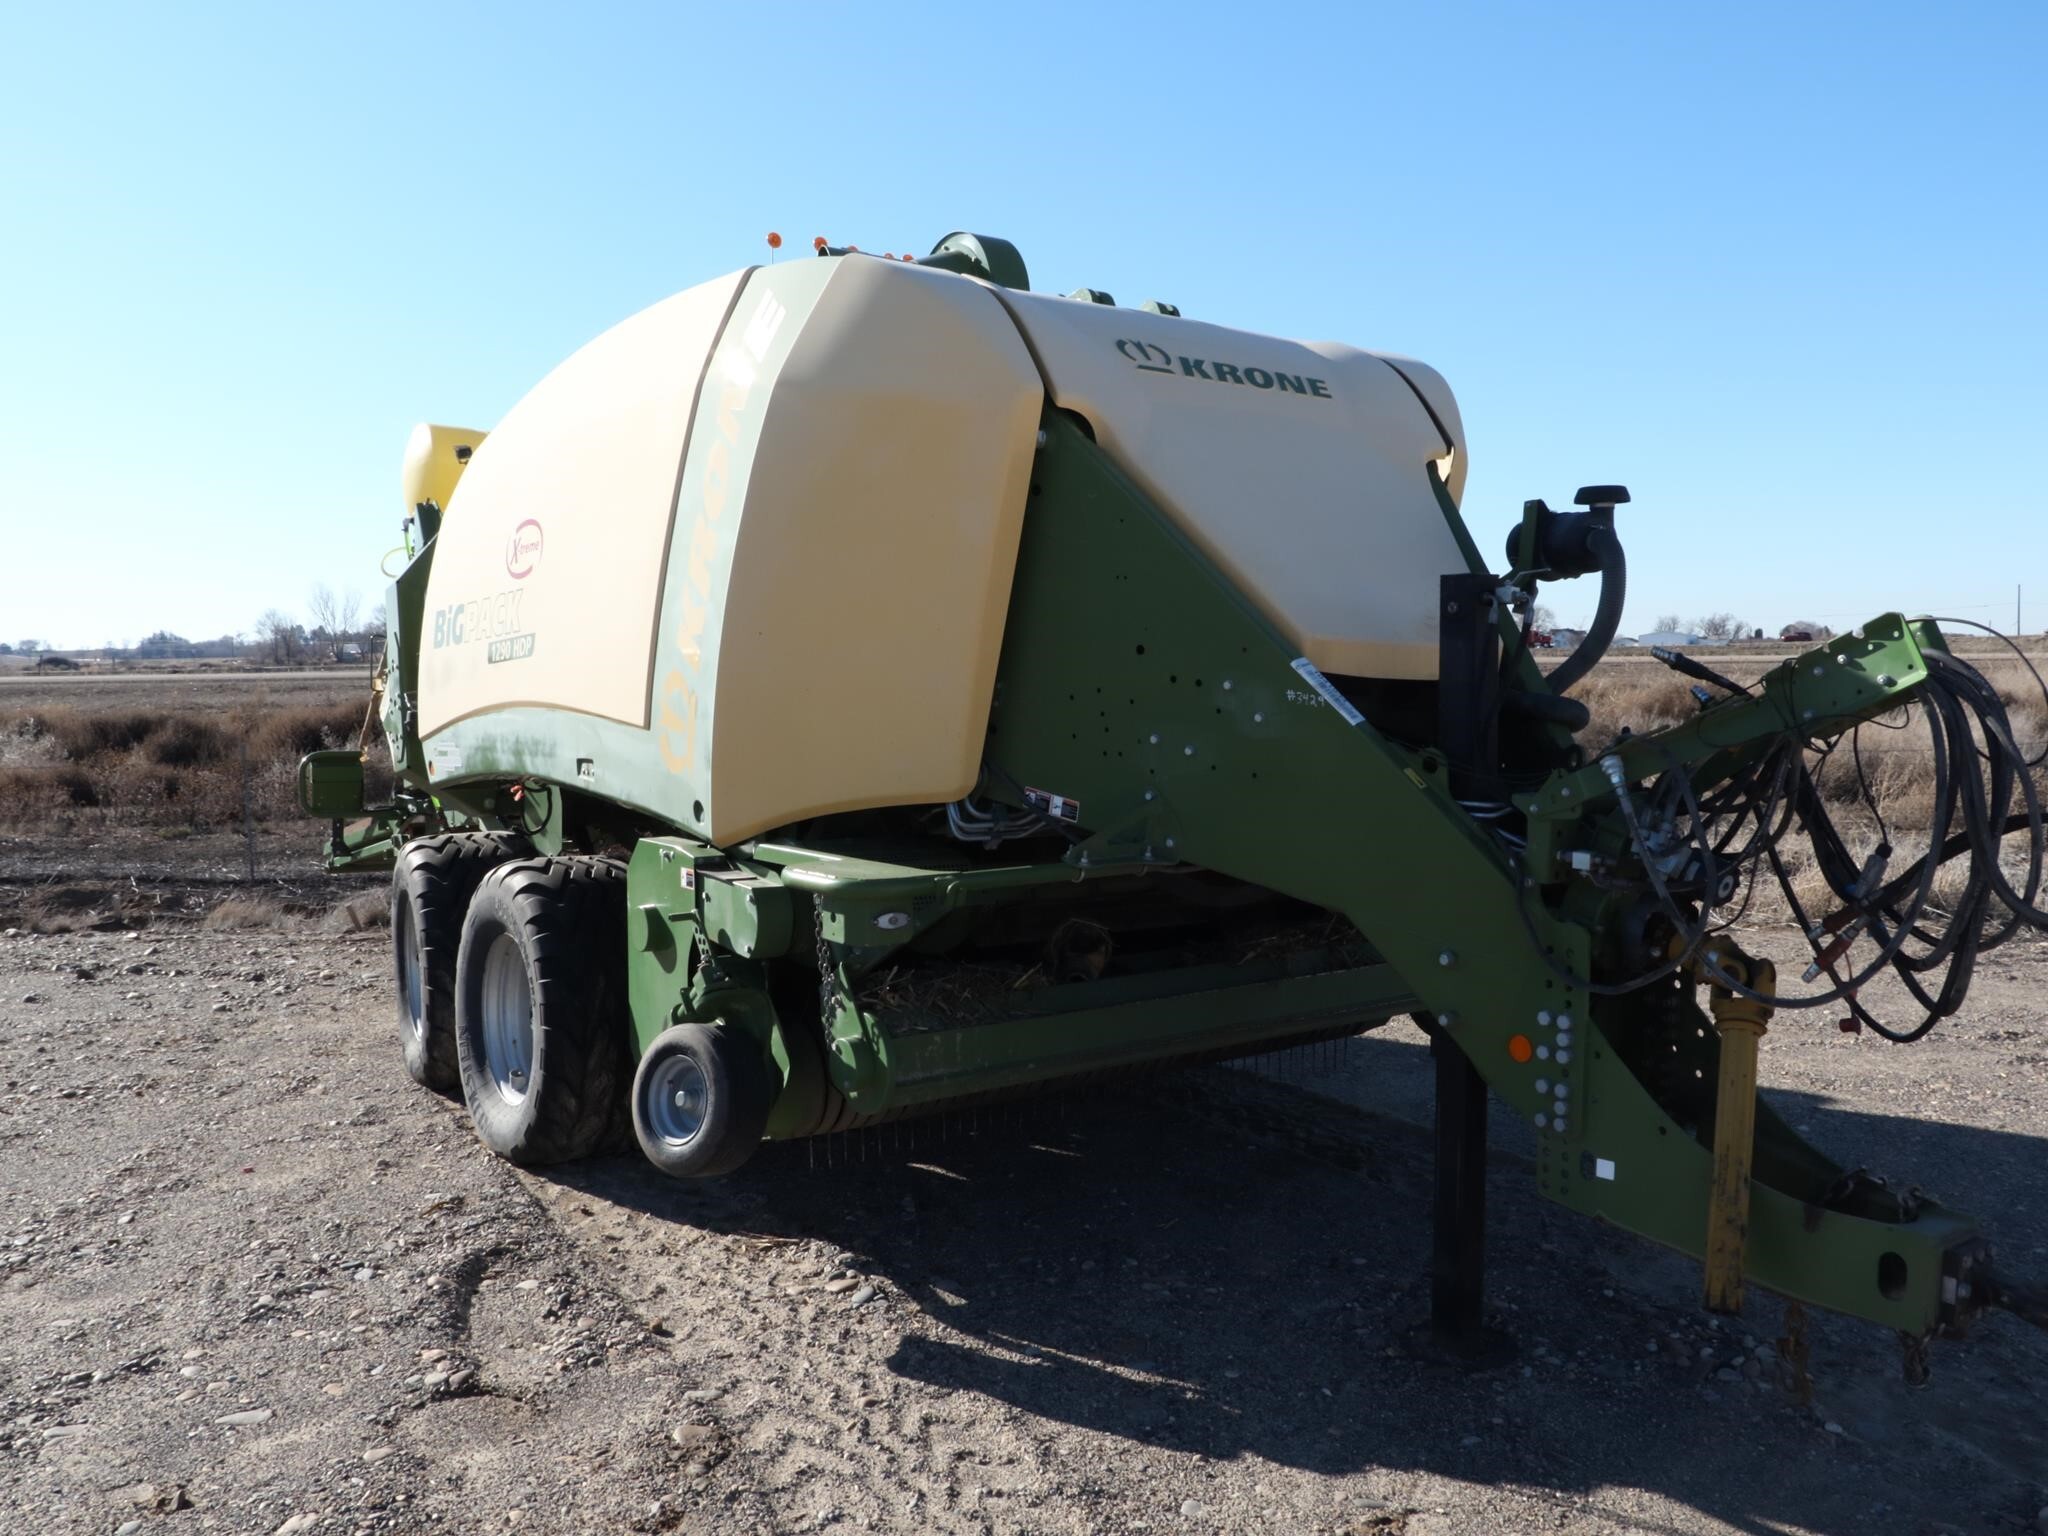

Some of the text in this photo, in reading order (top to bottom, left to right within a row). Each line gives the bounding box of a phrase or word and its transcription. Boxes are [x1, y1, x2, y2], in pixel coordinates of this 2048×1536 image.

[1178, 356, 1333, 399] KRONE
[491, 634, 533, 662] 1290 HDP
